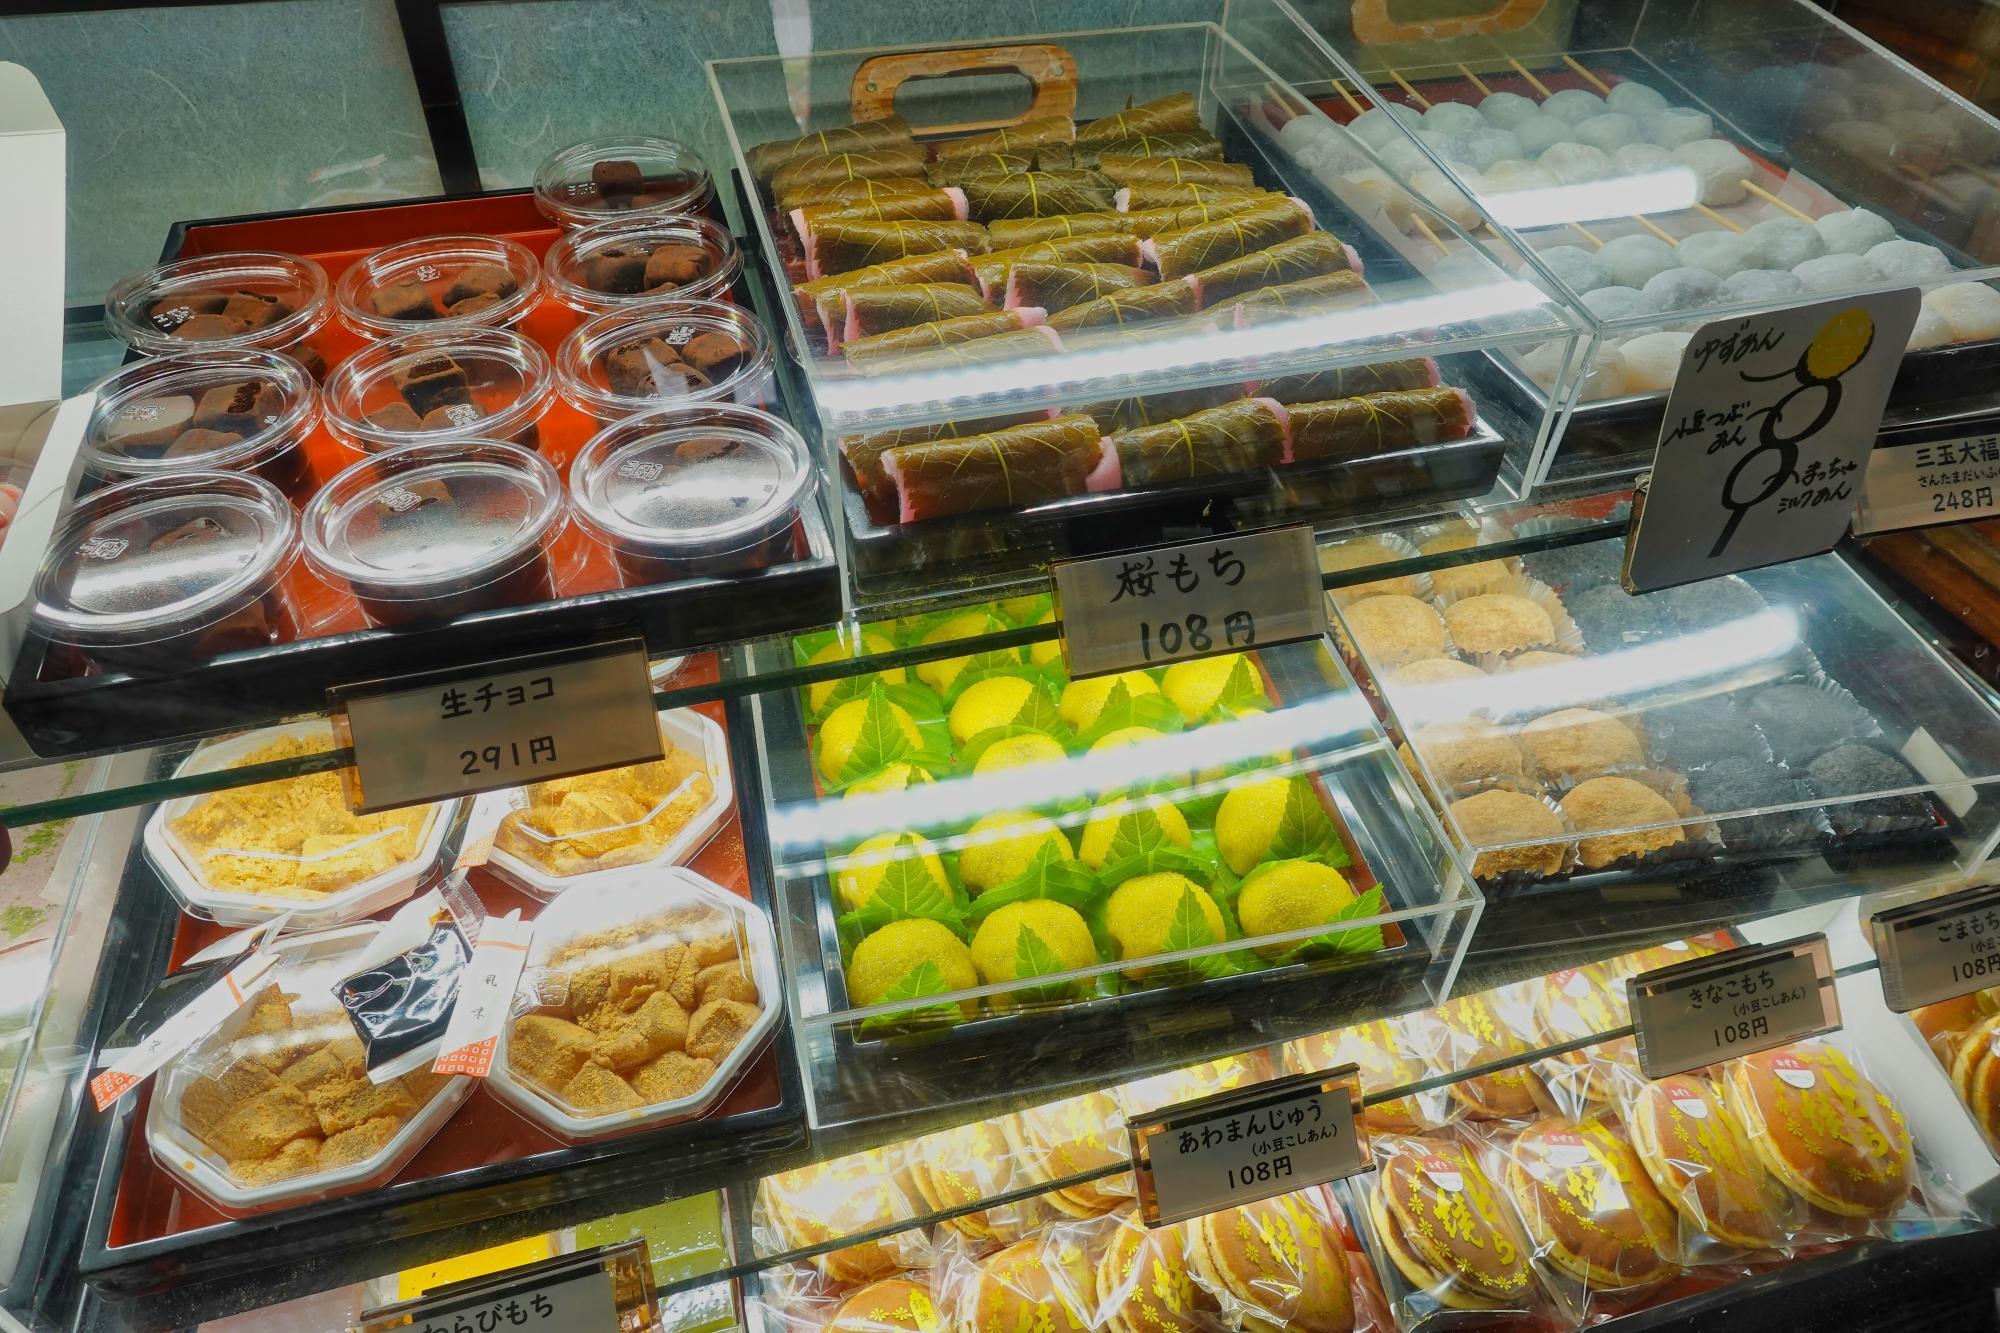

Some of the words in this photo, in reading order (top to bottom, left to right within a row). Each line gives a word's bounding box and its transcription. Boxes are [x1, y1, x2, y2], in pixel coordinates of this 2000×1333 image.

[1694, 319, 1785, 374] ゆずあん
[1662, 400, 1752, 447] 小豆つぶ
[1707, 425, 1747, 455] あん
[1915, 437, 1999, 468] 三玉大福
[1801, 457, 1858, 486] まっちゃ
[1917, 466, 2000, 488] さんたまだいふ
[1932, 486, 1993, 513] 248円
[1109, 547, 1246, 603] 桜もち
[1140, 610, 1256, 661] 108円
[440, 676, 555, 720] 生チョコ
[459, 735, 557, 776] 291円
[1938, 911, 2000, 942] ごまもち
[1953, 953, 2000, 983] 108円
[1688, 968, 1775, 1009] きなこもち
[1733, 986, 1807, 1018] (小豆こしあん)
[1713, 1015, 1770, 1047] 108円
[1178, 1098, 1322, 1155] あわまんじゅう
[1251, 1122, 1338, 1157] (小豆こしあん)
[1227, 1155, 1293, 1190] 108円
